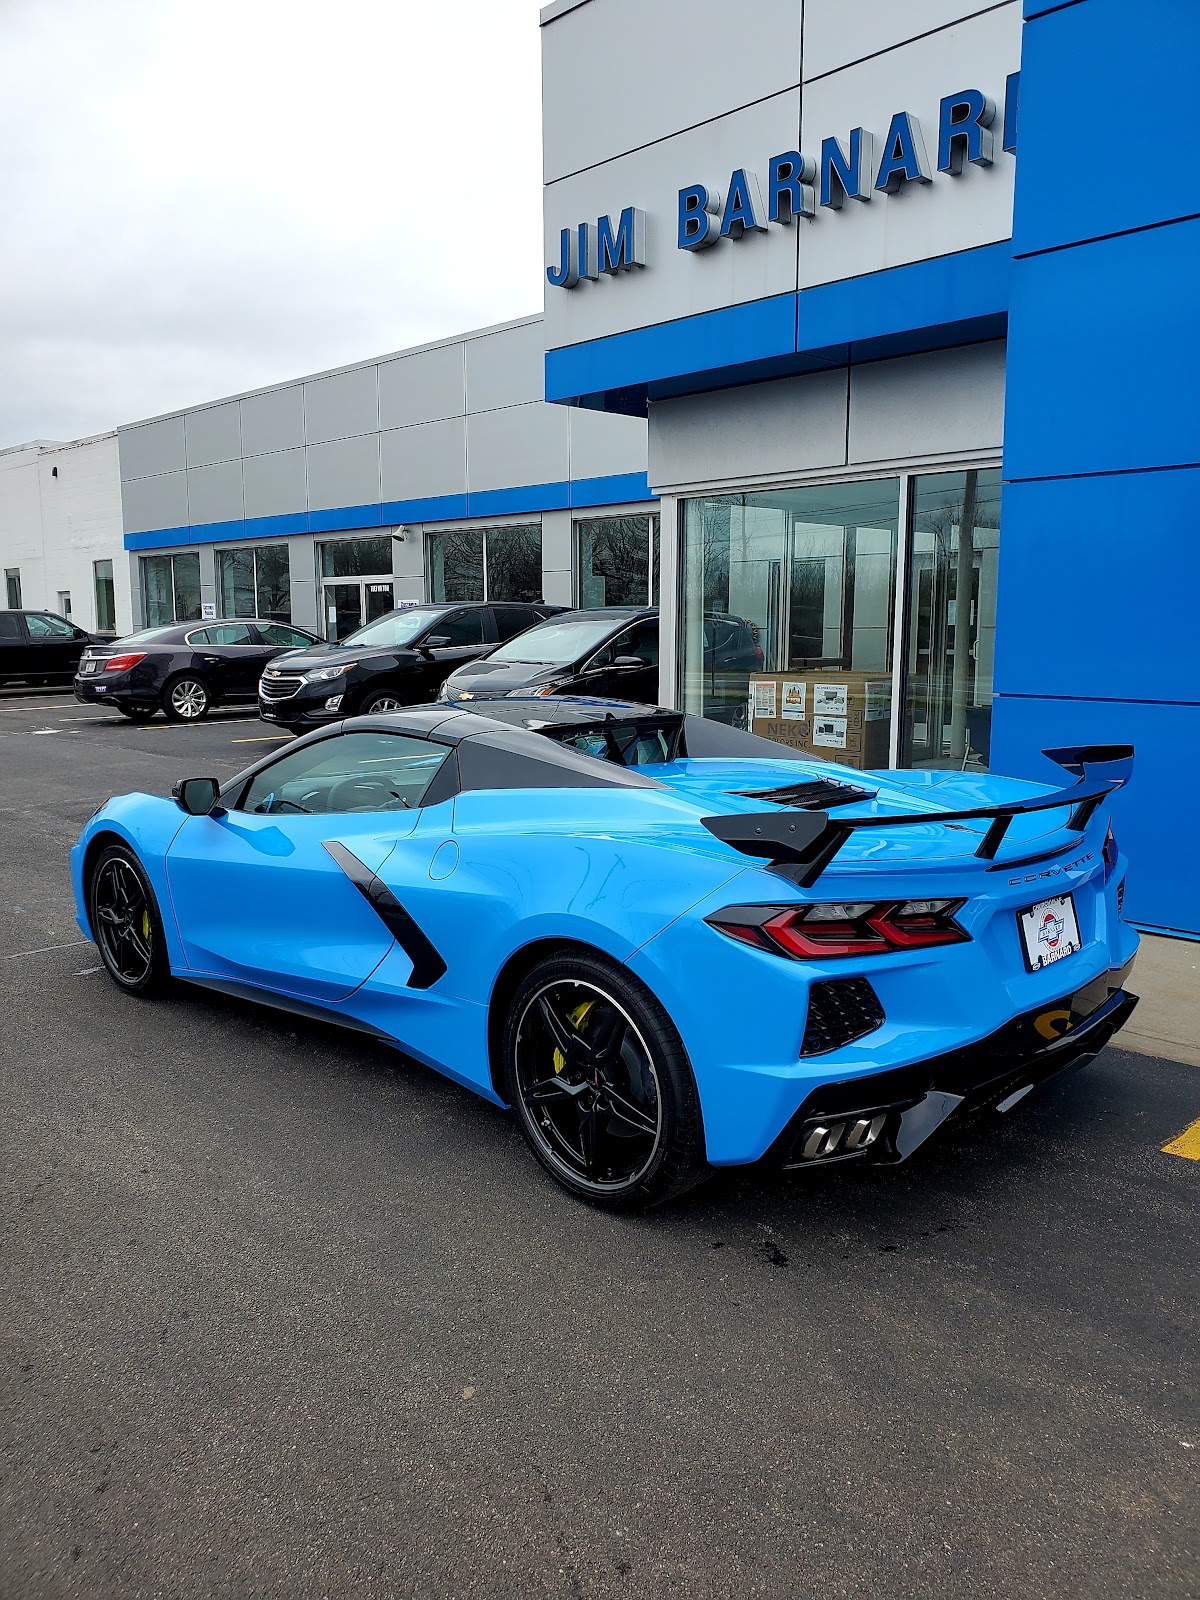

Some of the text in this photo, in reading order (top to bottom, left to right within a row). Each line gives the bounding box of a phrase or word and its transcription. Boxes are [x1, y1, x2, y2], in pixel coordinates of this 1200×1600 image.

[547, 71, 1020, 287] JIM BARNAR
[1009, 852, 1094, 885] CORVETTE
[1042, 945, 1072, 967] BARNARD
